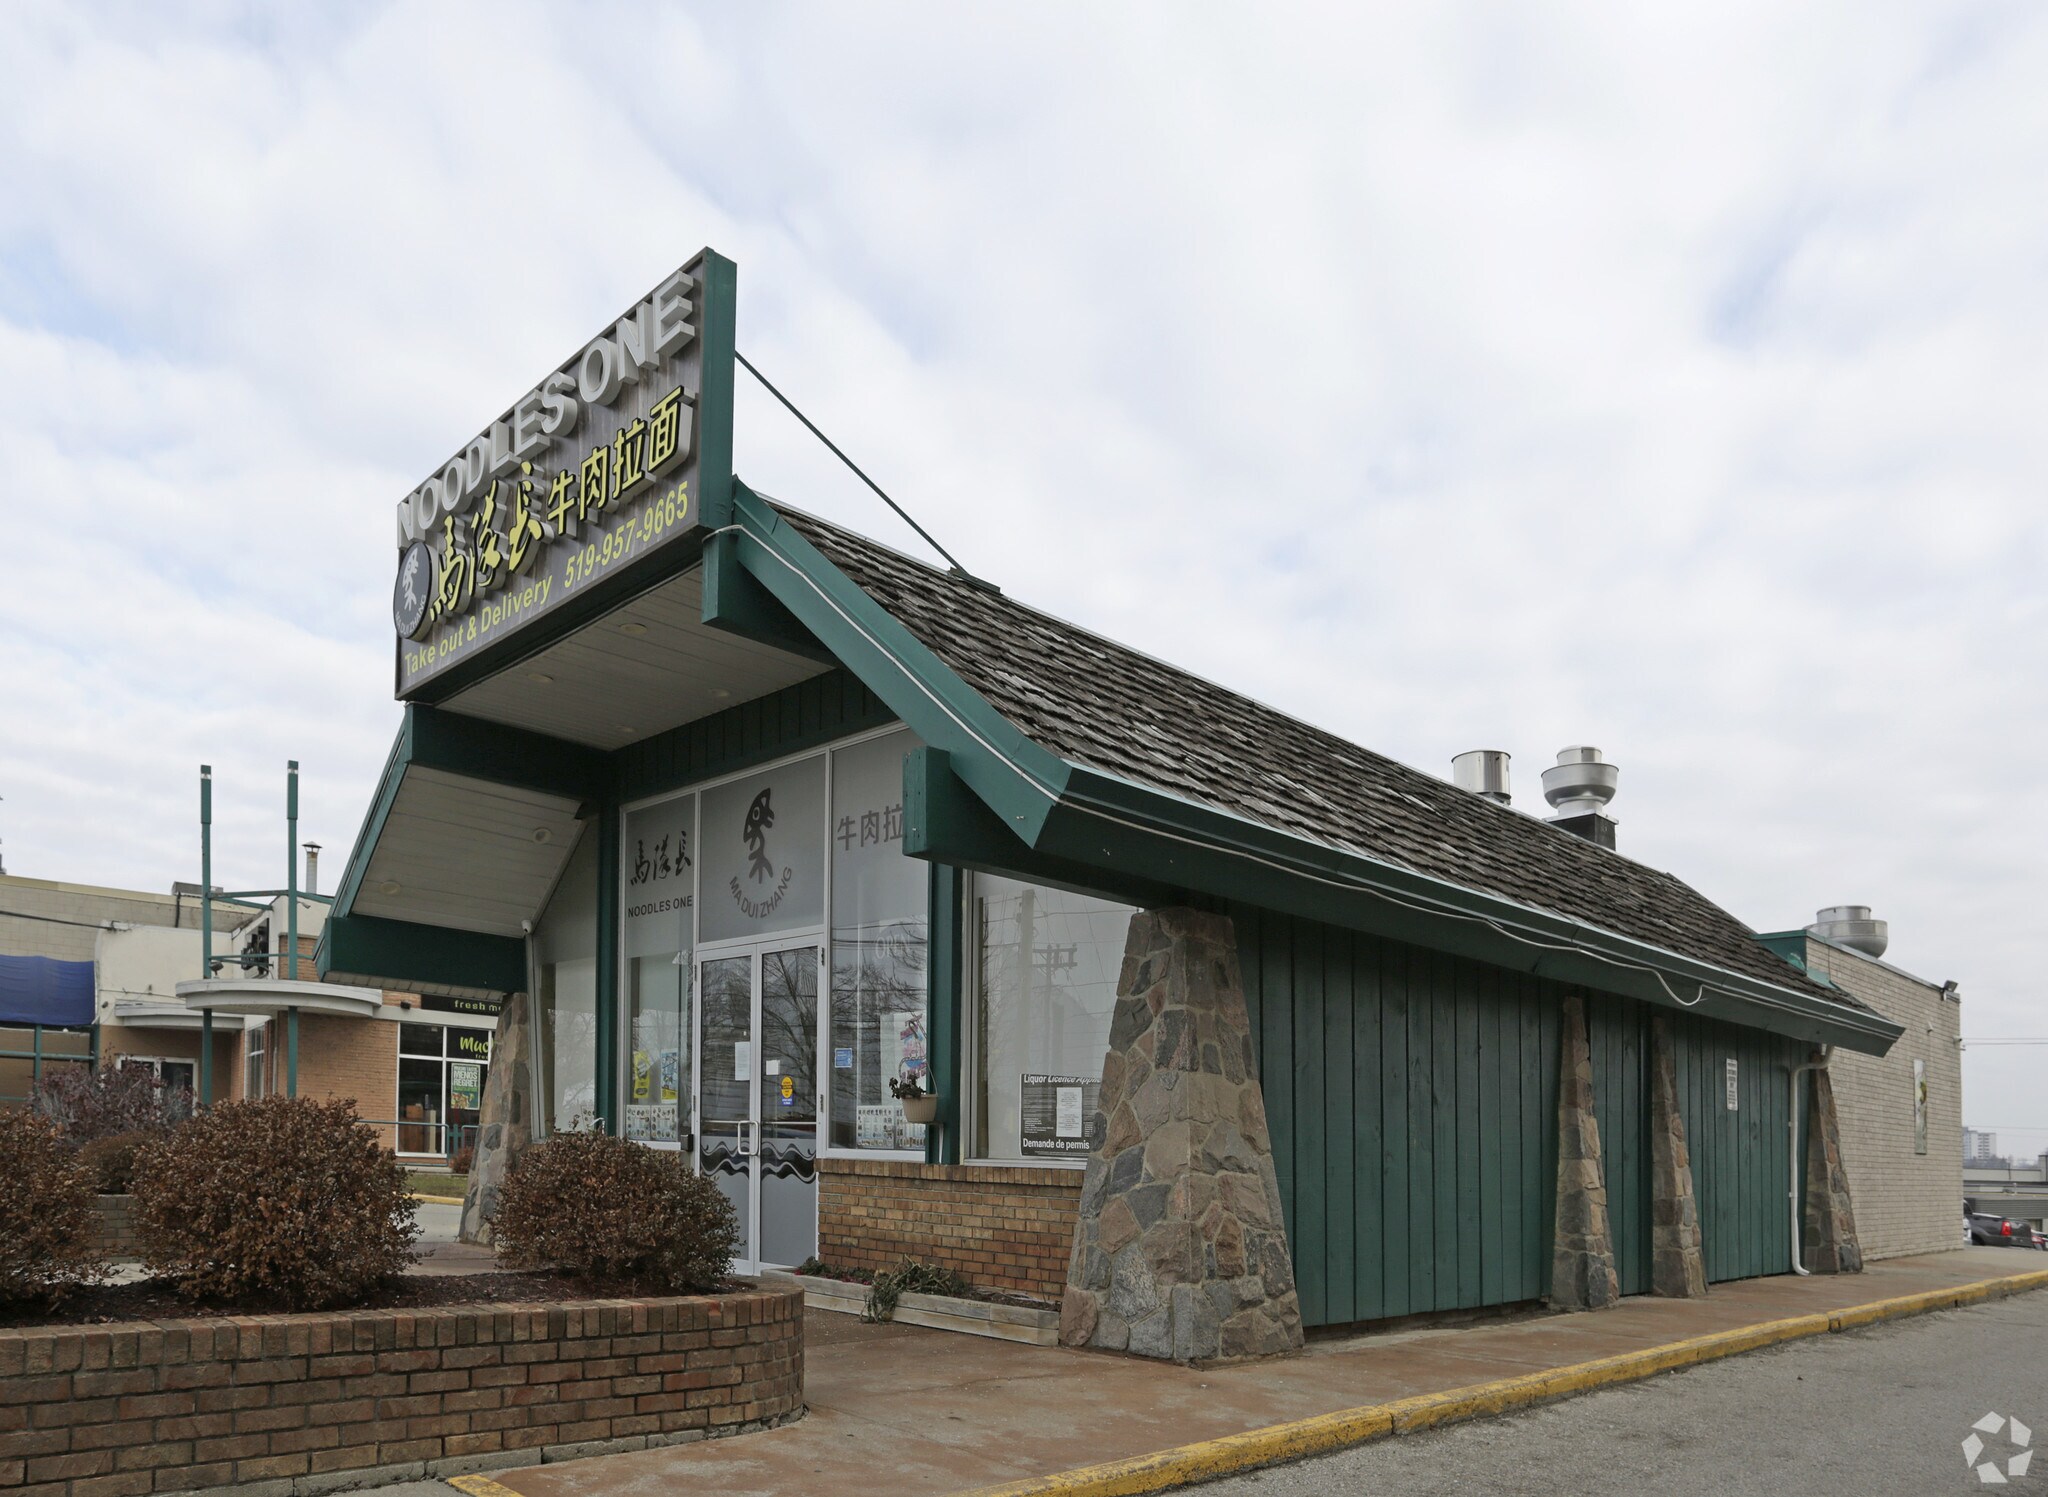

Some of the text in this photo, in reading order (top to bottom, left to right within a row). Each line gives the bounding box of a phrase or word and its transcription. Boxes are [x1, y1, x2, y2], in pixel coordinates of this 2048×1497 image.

[398, 270, 695, 547] NOODLES ONE
[405, 480, 688, 677] Take out & Delivery 519-957-9665
[627, 895, 693, 919] NOODLES ONE
[455, 1000, 486, 1010] fresh
[460, 1036, 494, 1053] Muc
[1024, 1074, 1047, 1085] Liquor
[1023, 1138, 1090, 1151] Demande de permis
